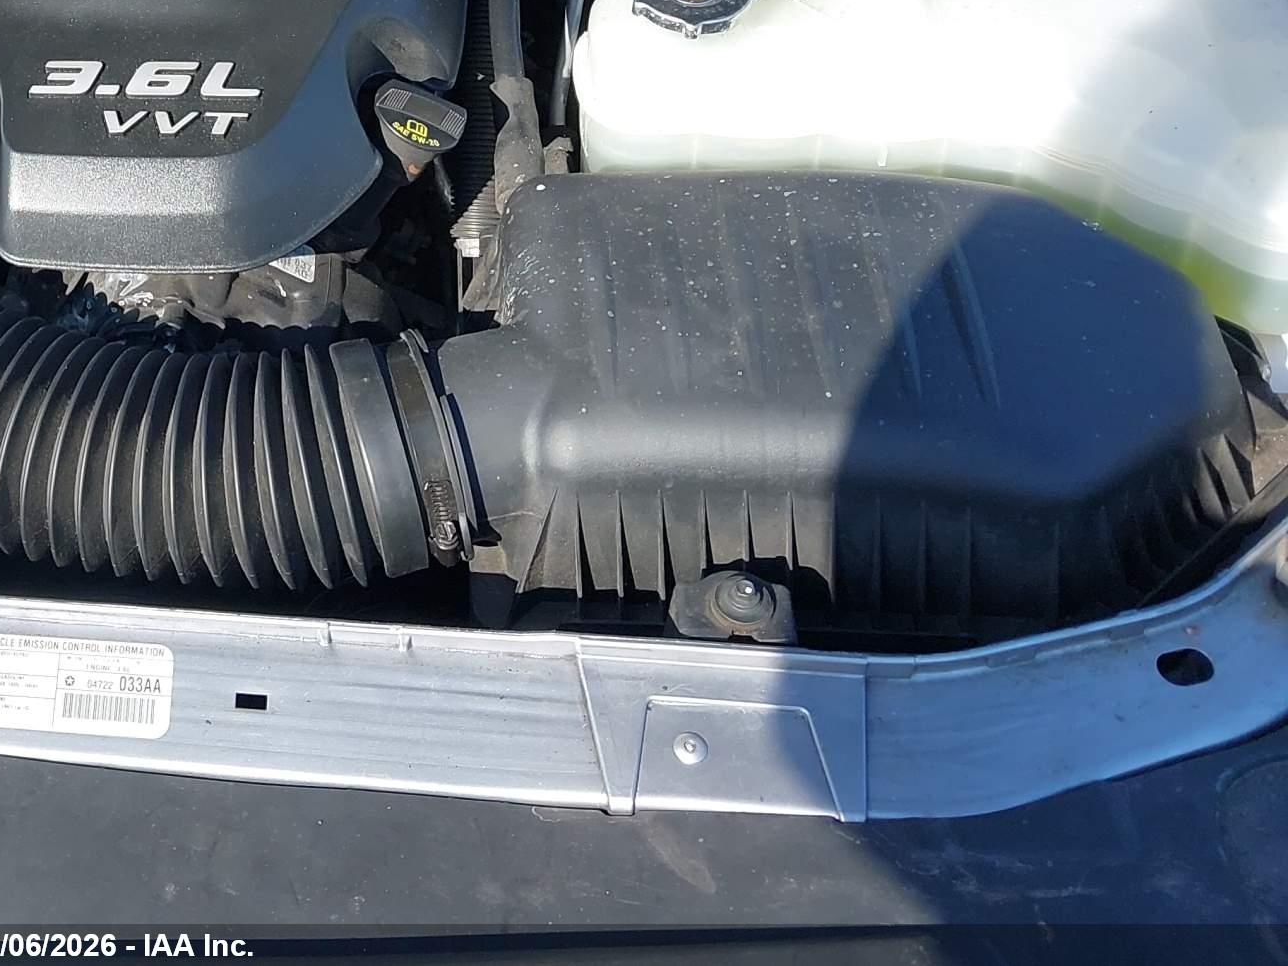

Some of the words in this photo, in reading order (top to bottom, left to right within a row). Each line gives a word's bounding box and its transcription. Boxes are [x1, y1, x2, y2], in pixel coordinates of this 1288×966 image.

[28, 60, 261, 99] 3.6L
[103, 110, 250, 136] VVT
[392, 121, 410, 137] SAE
[411, 135, 441, 147] 5W-20
[18, 638, 59, 651] EMISSION
[62, 641, 101, 652] CONTROL
[104, 644, 165, 657] INFORMATION
[87, 679, 114, 690] 04722
[119, 675, 161, 694] 033AA
